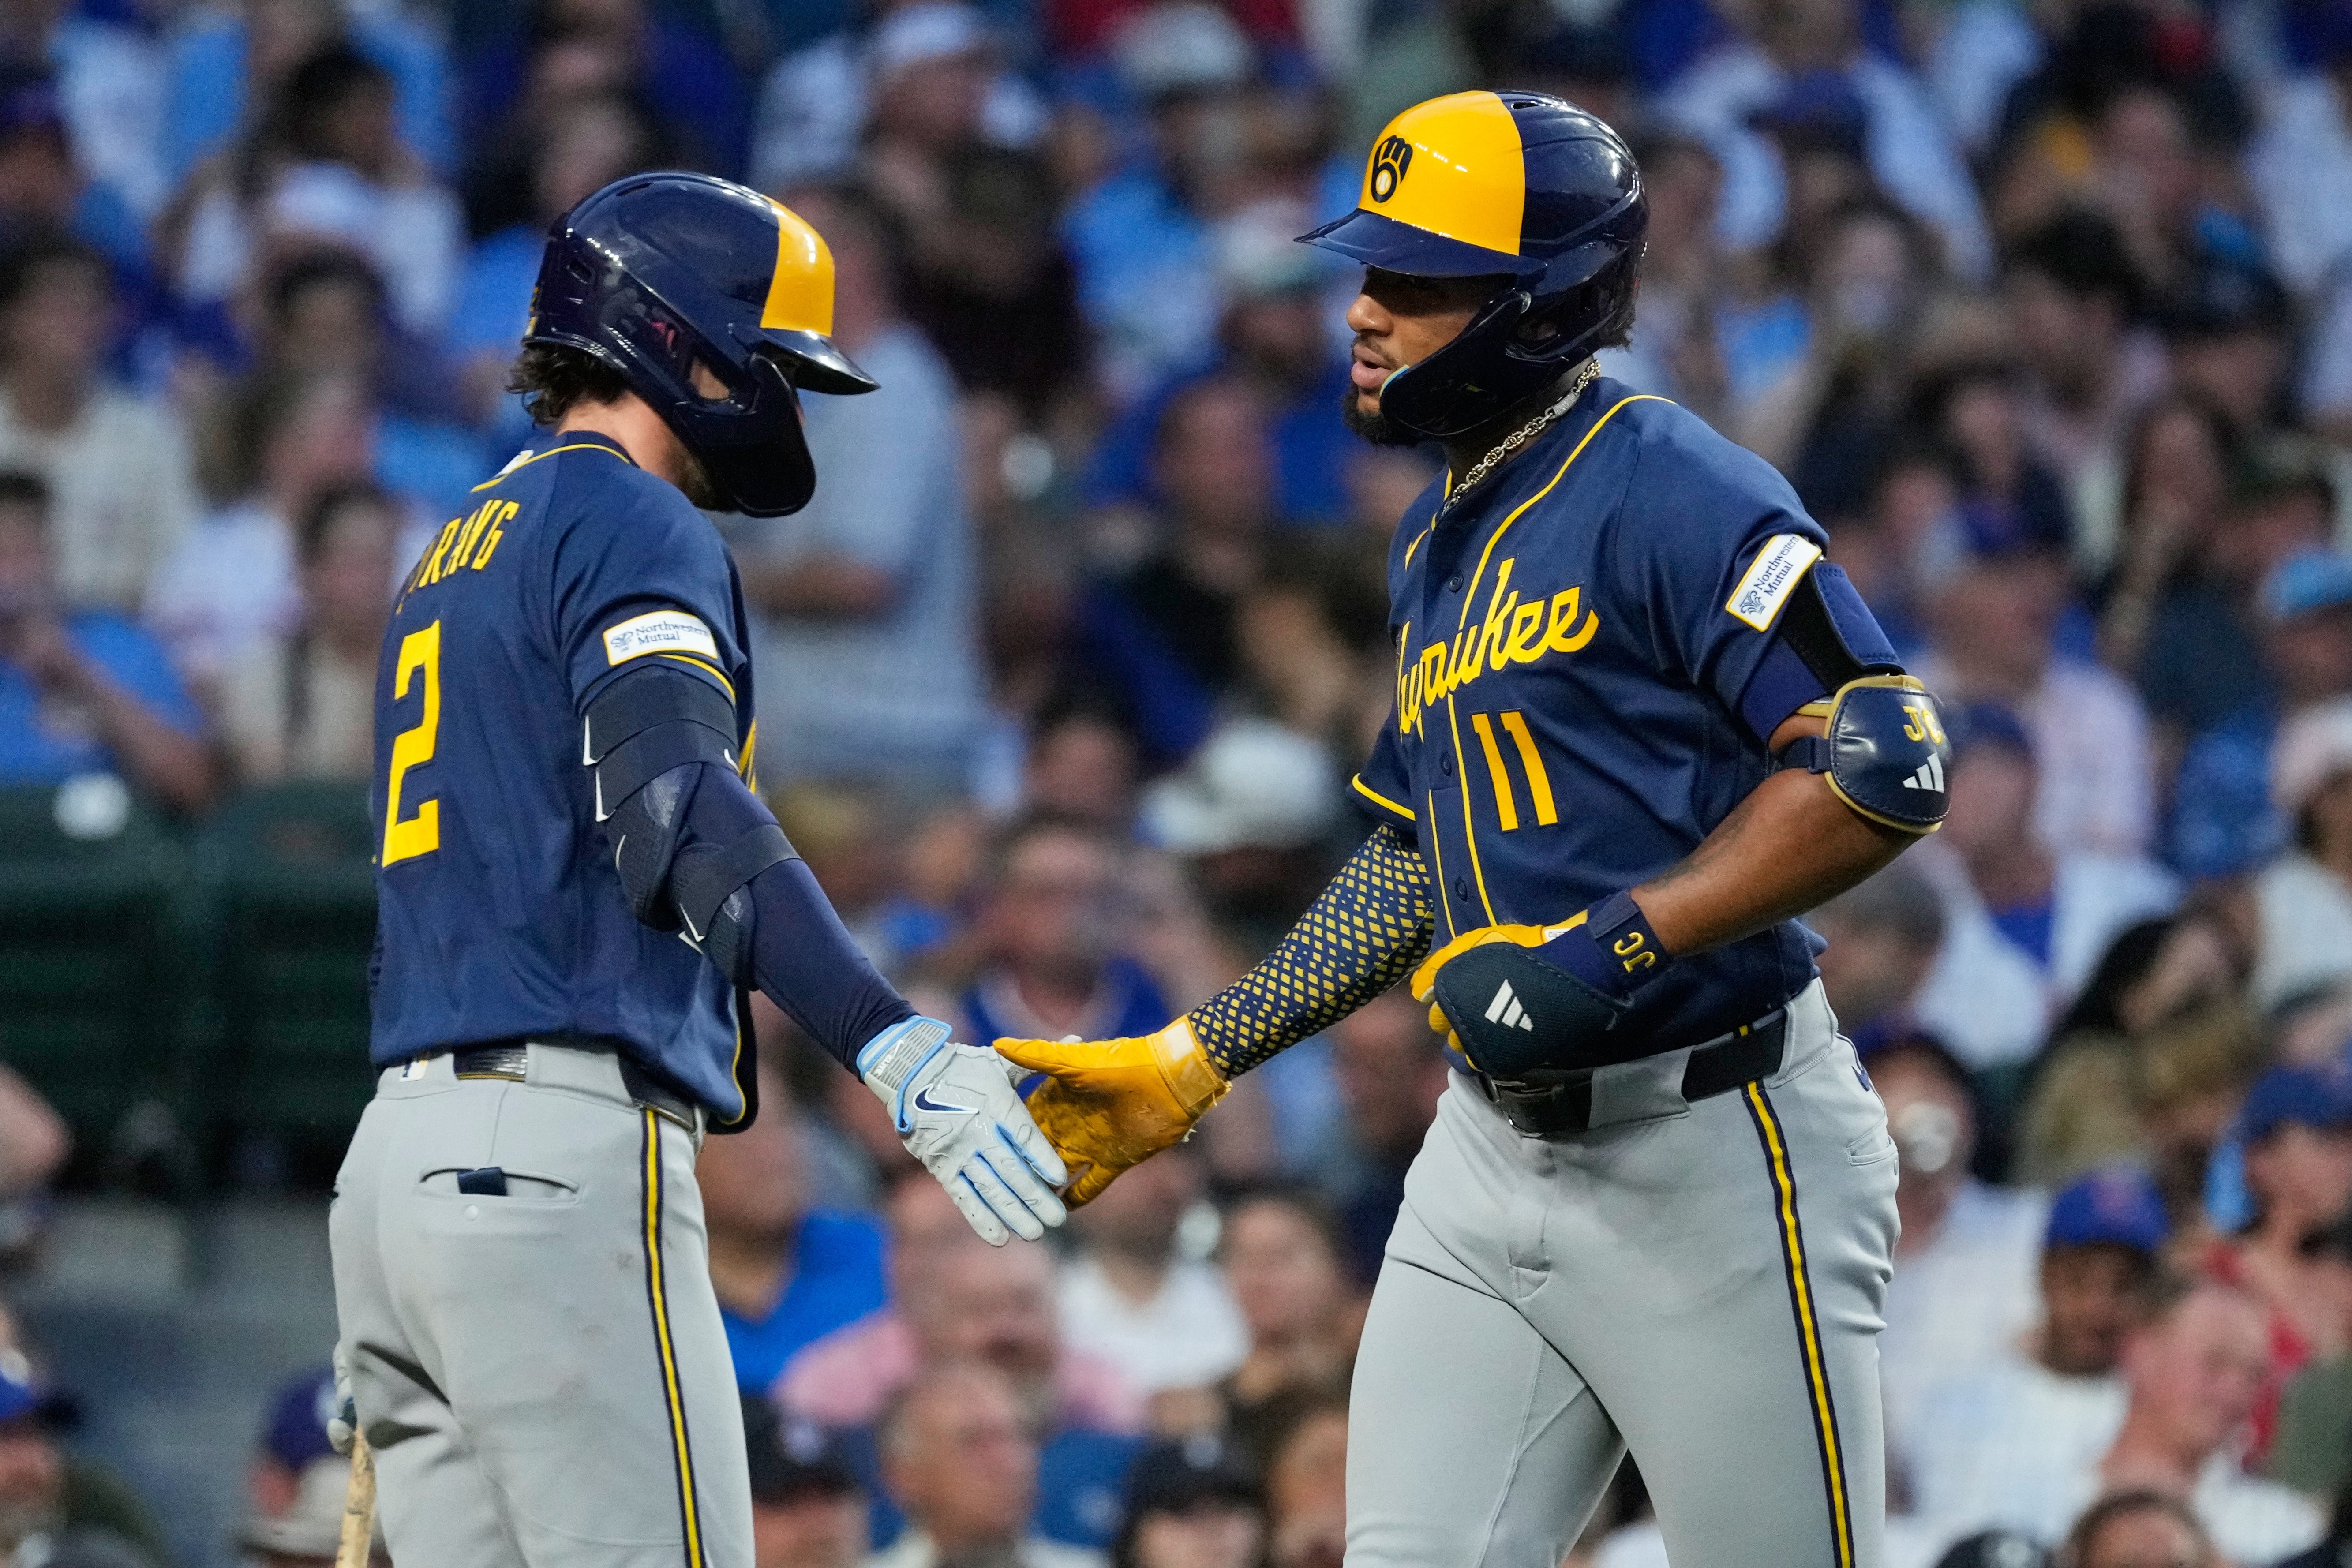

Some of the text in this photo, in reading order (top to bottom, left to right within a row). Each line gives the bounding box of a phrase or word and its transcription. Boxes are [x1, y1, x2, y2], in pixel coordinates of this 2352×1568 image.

[396, 499, 520, 614] RANG
[1753, 536, 1800, 591] Northwestern
[1763, 561, 1794, 597] Mutual
[637, 630, 680, 645] Mutual
[382, 619, 440, 868] 2
[1903, 706, 1943, 745] JC
[1471, 711, 1558, 831] 11
[1614, 932, 1656, 973] JC
